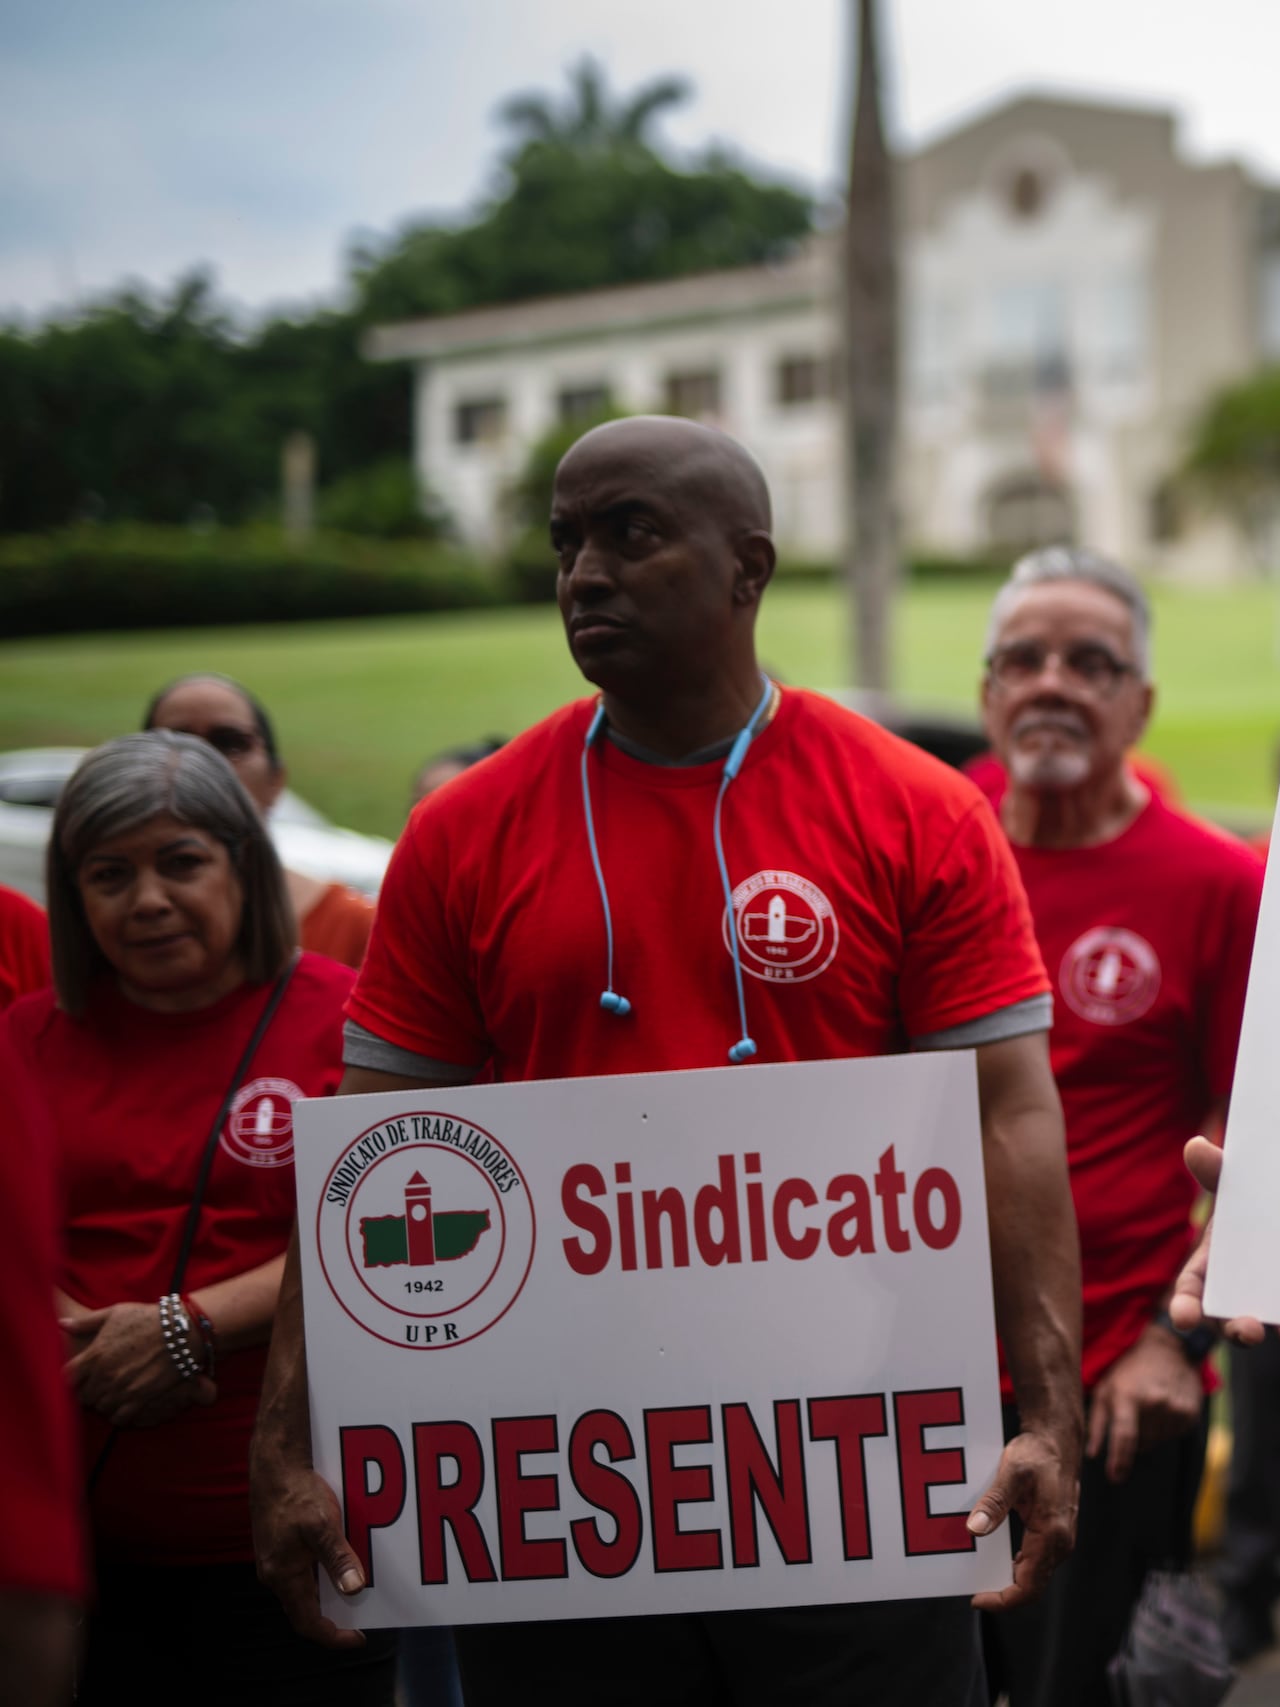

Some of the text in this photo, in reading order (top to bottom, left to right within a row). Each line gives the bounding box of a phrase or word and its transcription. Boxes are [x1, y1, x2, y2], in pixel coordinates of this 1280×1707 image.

[326, 1116, 520, 1207] SINDICATO DE TRABAJADORES
[561, 1143, 963, 1276] Sindicato
[404, 1279, 444, 1294] 1942
[338, 1387, 977, 1588] PRESENTE
